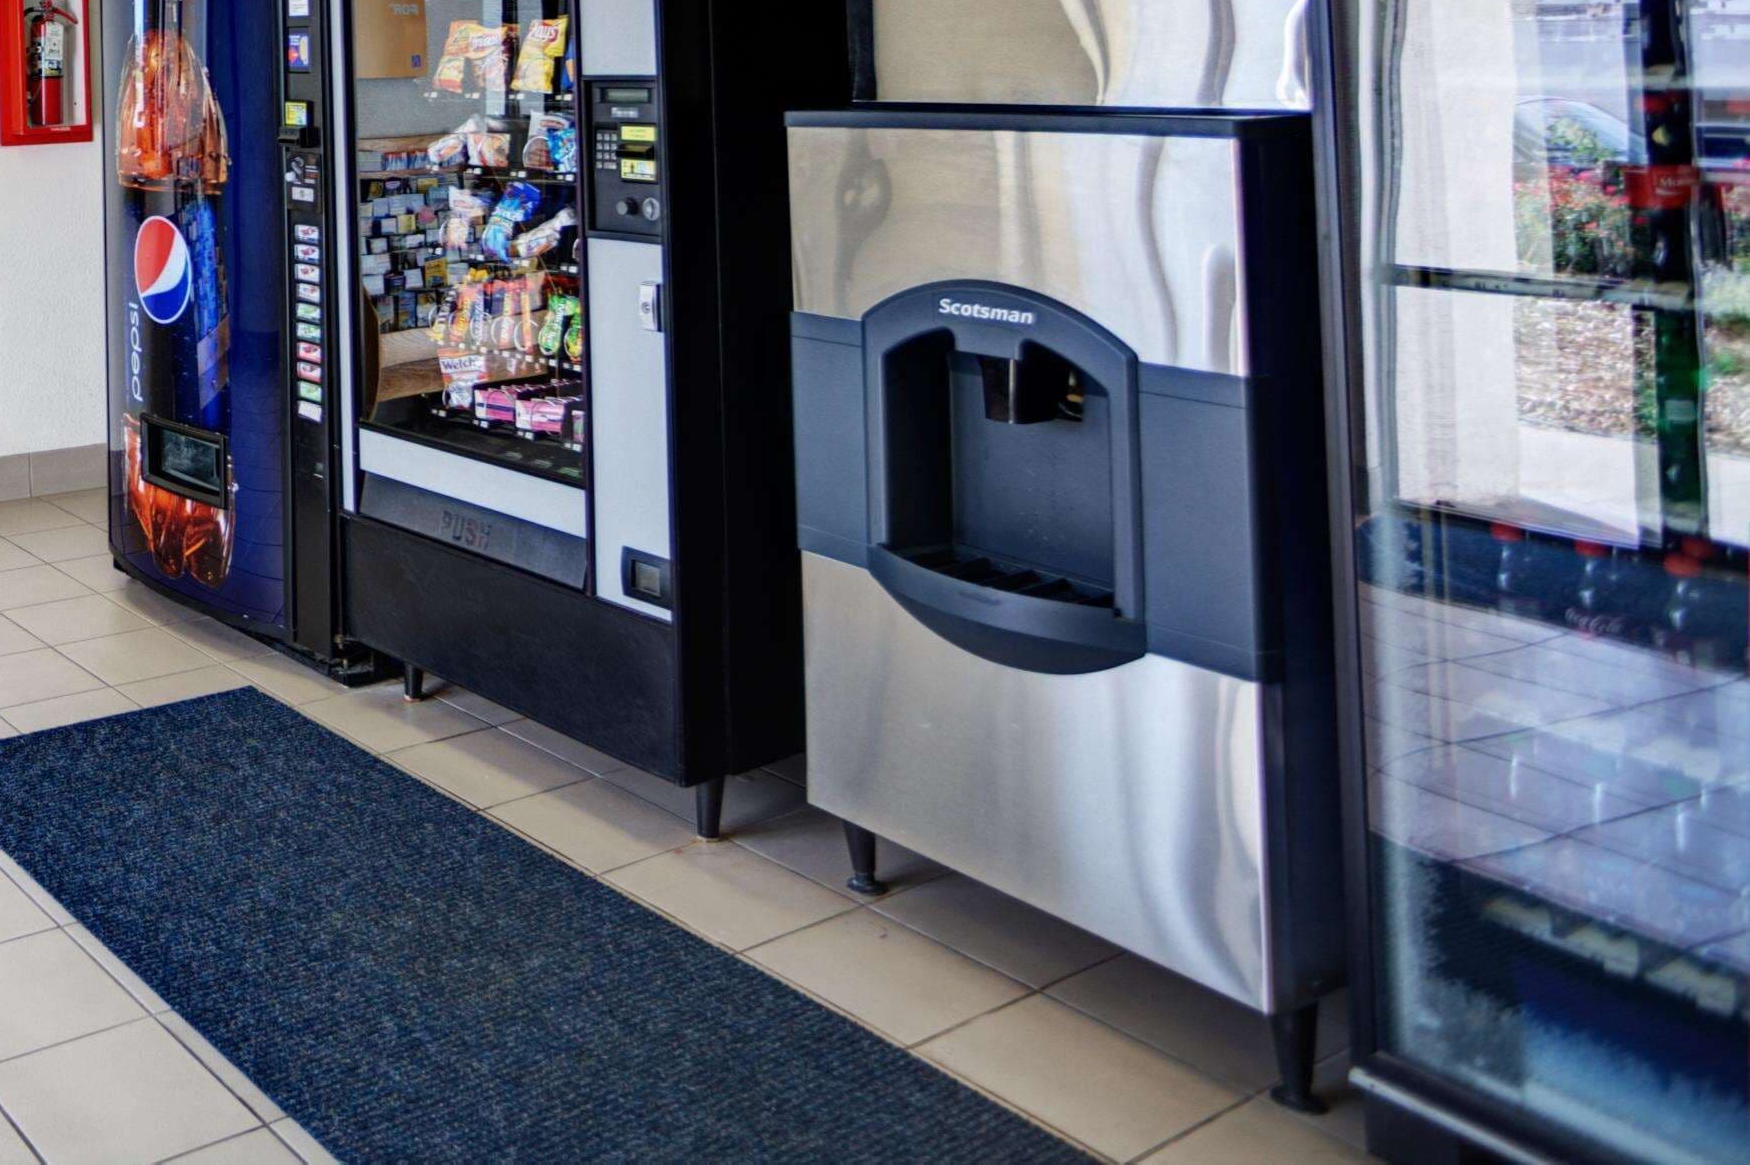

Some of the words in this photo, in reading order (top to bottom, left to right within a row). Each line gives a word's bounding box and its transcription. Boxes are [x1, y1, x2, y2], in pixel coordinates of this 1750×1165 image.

[938, 298, 1034, 324] Scotsman
[129, 302, 143, 402] pepsi
[441, 510, 492, 551] PUSH
